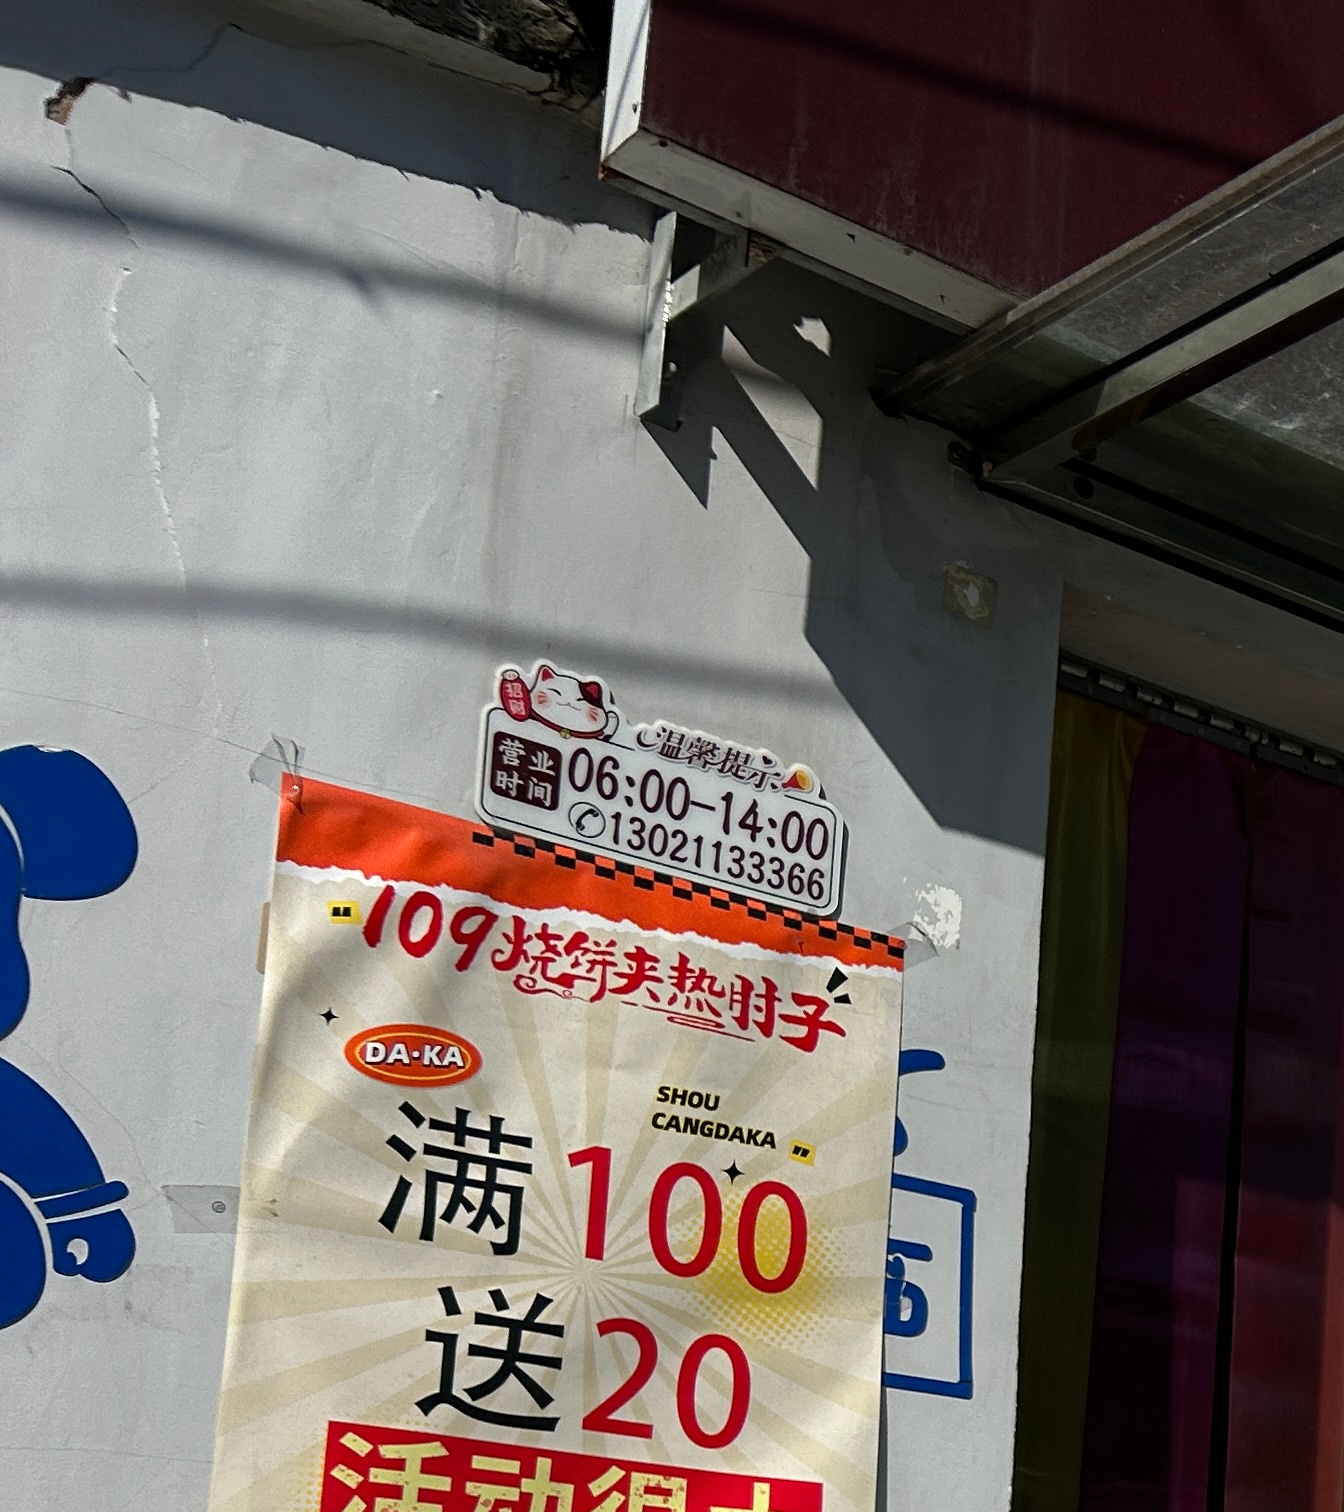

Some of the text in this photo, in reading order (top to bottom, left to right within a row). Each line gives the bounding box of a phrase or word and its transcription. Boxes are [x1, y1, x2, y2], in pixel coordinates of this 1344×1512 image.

[496, 771, 554, 807] 时间
[501, 737, 557, 777] 营业
[650, 724, 783, 791] 温馨提示
[611, 811, 825, 900] 13021133366
[362, 884, 847, 1054] 109烧饼夹热肘子
[651, 1112, 777, 1150] CANGDAKA
[656, 1085, 721, 1112] SHOU
[379, 1101, 533, 1256] 满
[566, 1145, 808, 1294] 100
[415, 1286, 752, 1451] 送 20
